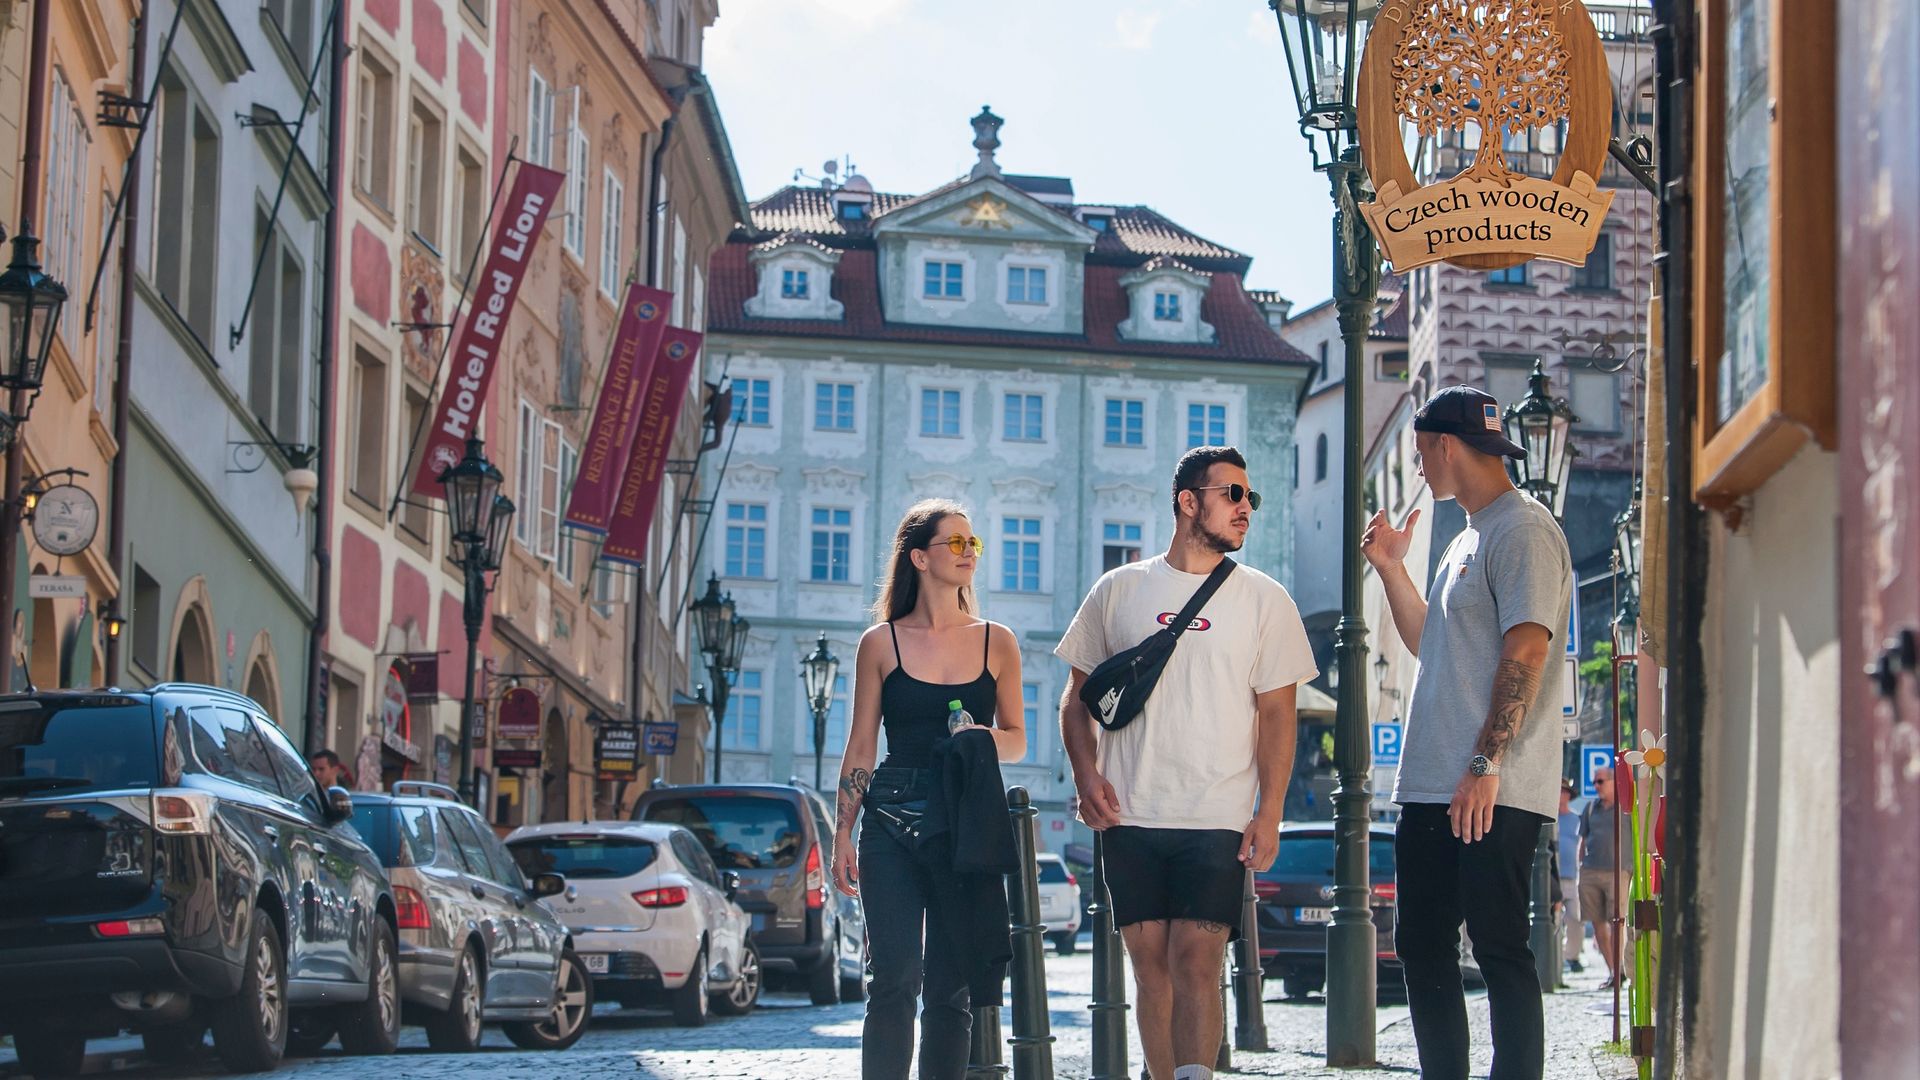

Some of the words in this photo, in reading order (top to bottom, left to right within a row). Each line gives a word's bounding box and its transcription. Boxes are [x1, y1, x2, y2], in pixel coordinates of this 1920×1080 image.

[1385, 188, 1471, 233] Czech
[1477, 189, 1590, 228] wooden
[1424, 217, 1552, 255] products
[442, 344, 489, 440] Hotel
[474, 270, 514, 340] Red
[500, 192, 545, 262] Lion
[585, 393, 622, 484] RESIDENCE
[612, 335, 640, 392] HOTEL
[620, 431, 655, 518] RESIDENCE
[645, 374, 670, 429] HOTEL
[39, 584, 74, 593] TERASA
[1098, 687, 1119, 714] NIKE
[601, 741, 637, 750] MARKET
[1378, 727, 1397, 754] P
[97, 869, 143, 878] OUTLANDER
